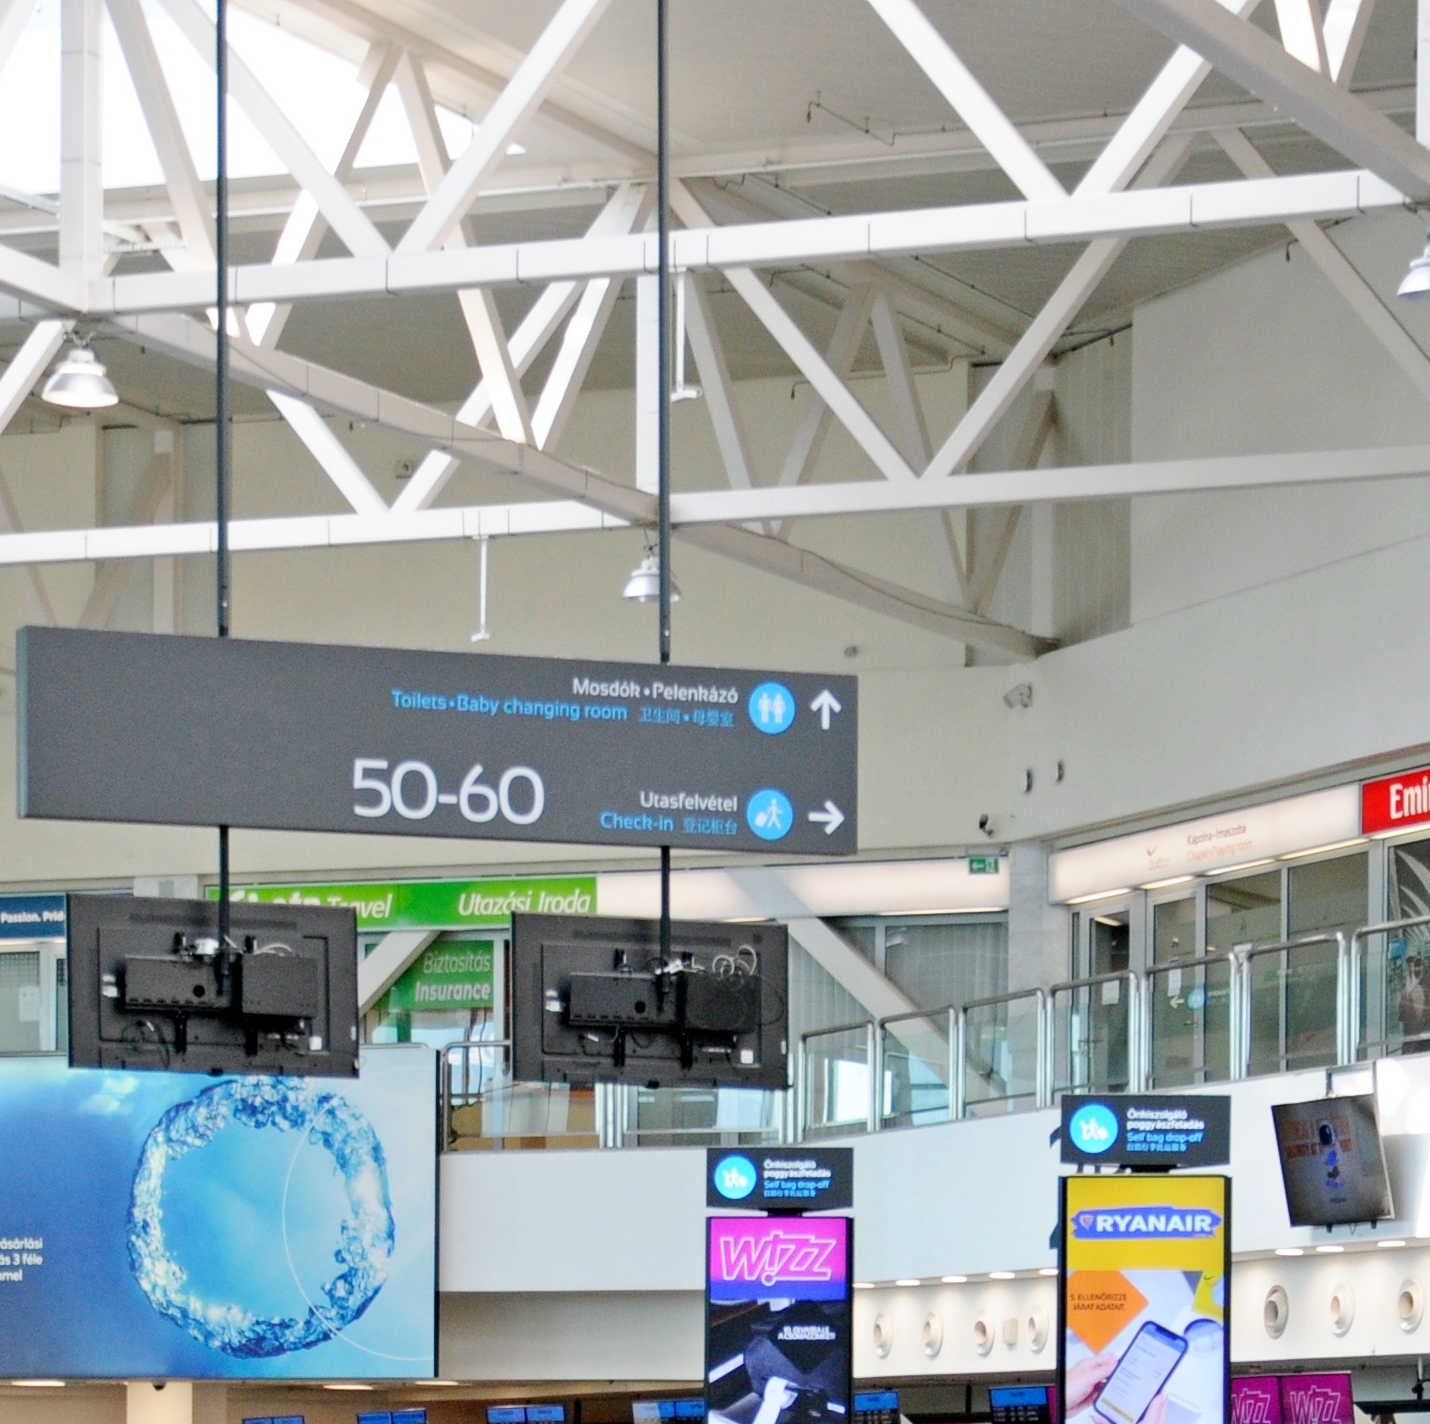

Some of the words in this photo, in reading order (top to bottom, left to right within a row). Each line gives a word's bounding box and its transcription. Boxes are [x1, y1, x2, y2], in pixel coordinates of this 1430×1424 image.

[572, 678, 640, 699] Mosdók
[653, 682, 738, 705] Pelenkázó
[392, 689, 447, 711] Toilets
[457, 694, 499, 720] Baby
[503, 698, 580, 721] changing
[585, 705, 627, 719] room
[353, 758, 545, 825] 50-60
[639, 790, 738, 813] Utasfelvétel
[600, 811, 673, 833] Check-in
[458, 889, 532, 916] Utazási
[538, 888, 590, 913] Iroda
[0, 911, 41, 925] Passion.
[43, 910, 65, 922] Prid
[423, 951, 491, 973] Biztosítás
[415, 981, 490, 1002] Insurance
[1127, 1131, 1146, 1142] Self
[1147, 1132, 1164, 1144] bag
[1165, 1131, 1204, 1143] drop-off
[1096, 1214, 1213, 1233] RYANAIR
[12, 1254, 20, 1265] 3
[22, 1253, 43, 1265] féle
